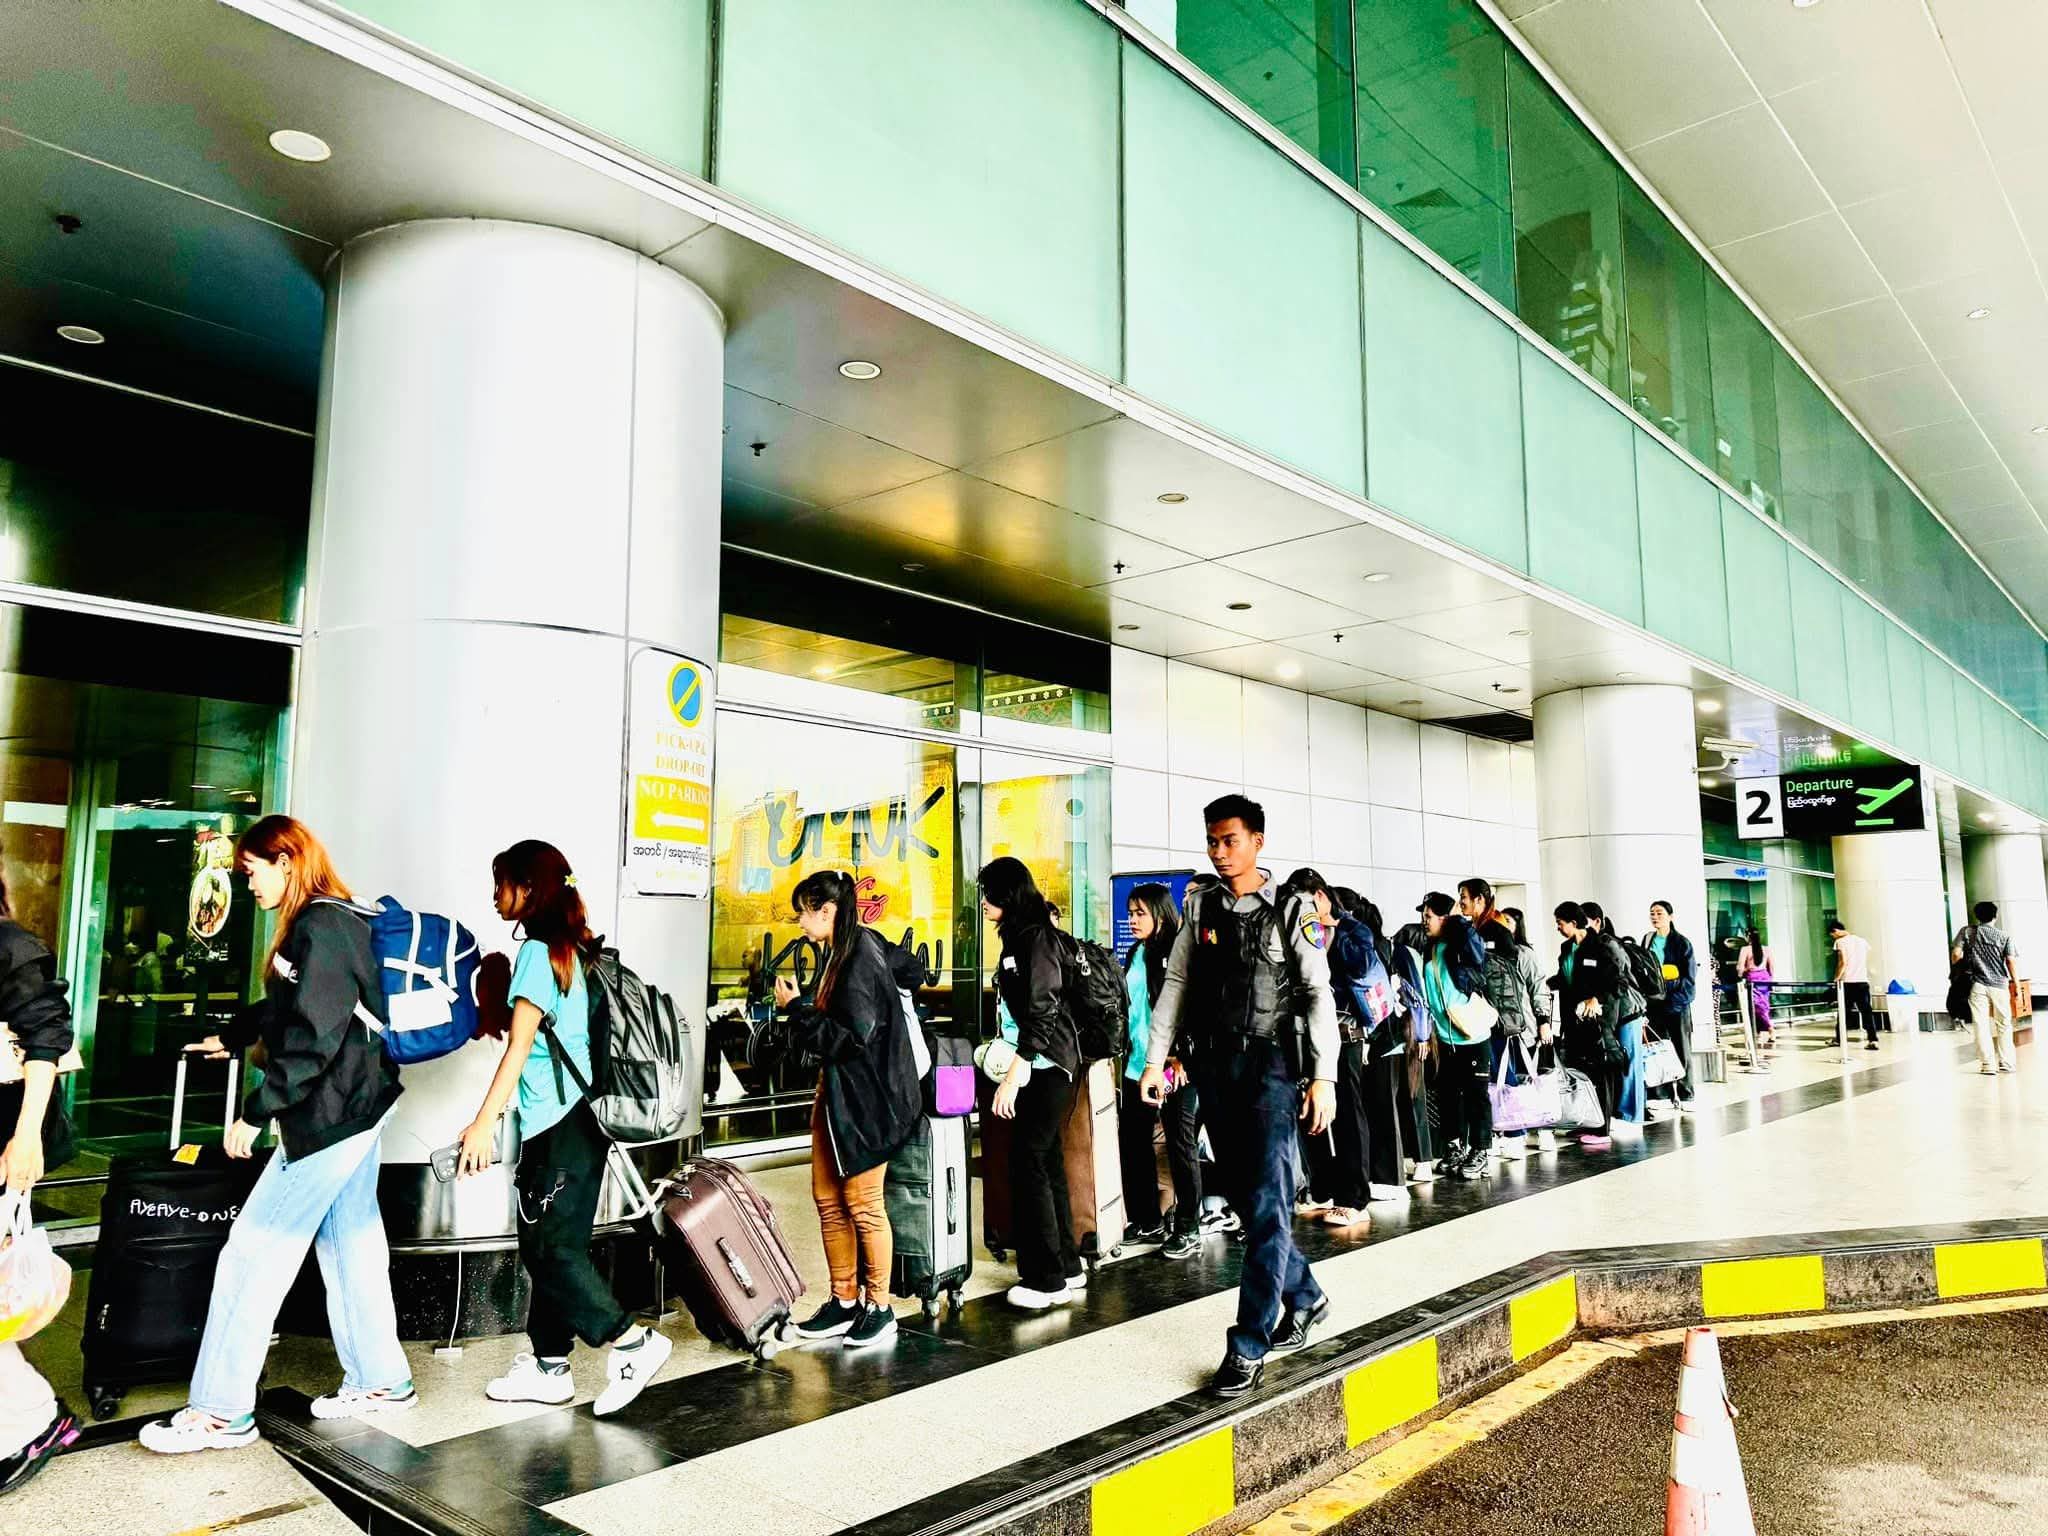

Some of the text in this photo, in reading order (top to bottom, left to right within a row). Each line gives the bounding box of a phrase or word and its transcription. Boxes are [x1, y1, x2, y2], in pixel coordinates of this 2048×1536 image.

[639, 779, 665, 800] NO
[1785, 777, 1854, 795] Departure
[1745, 790, 1774, 825] 2
